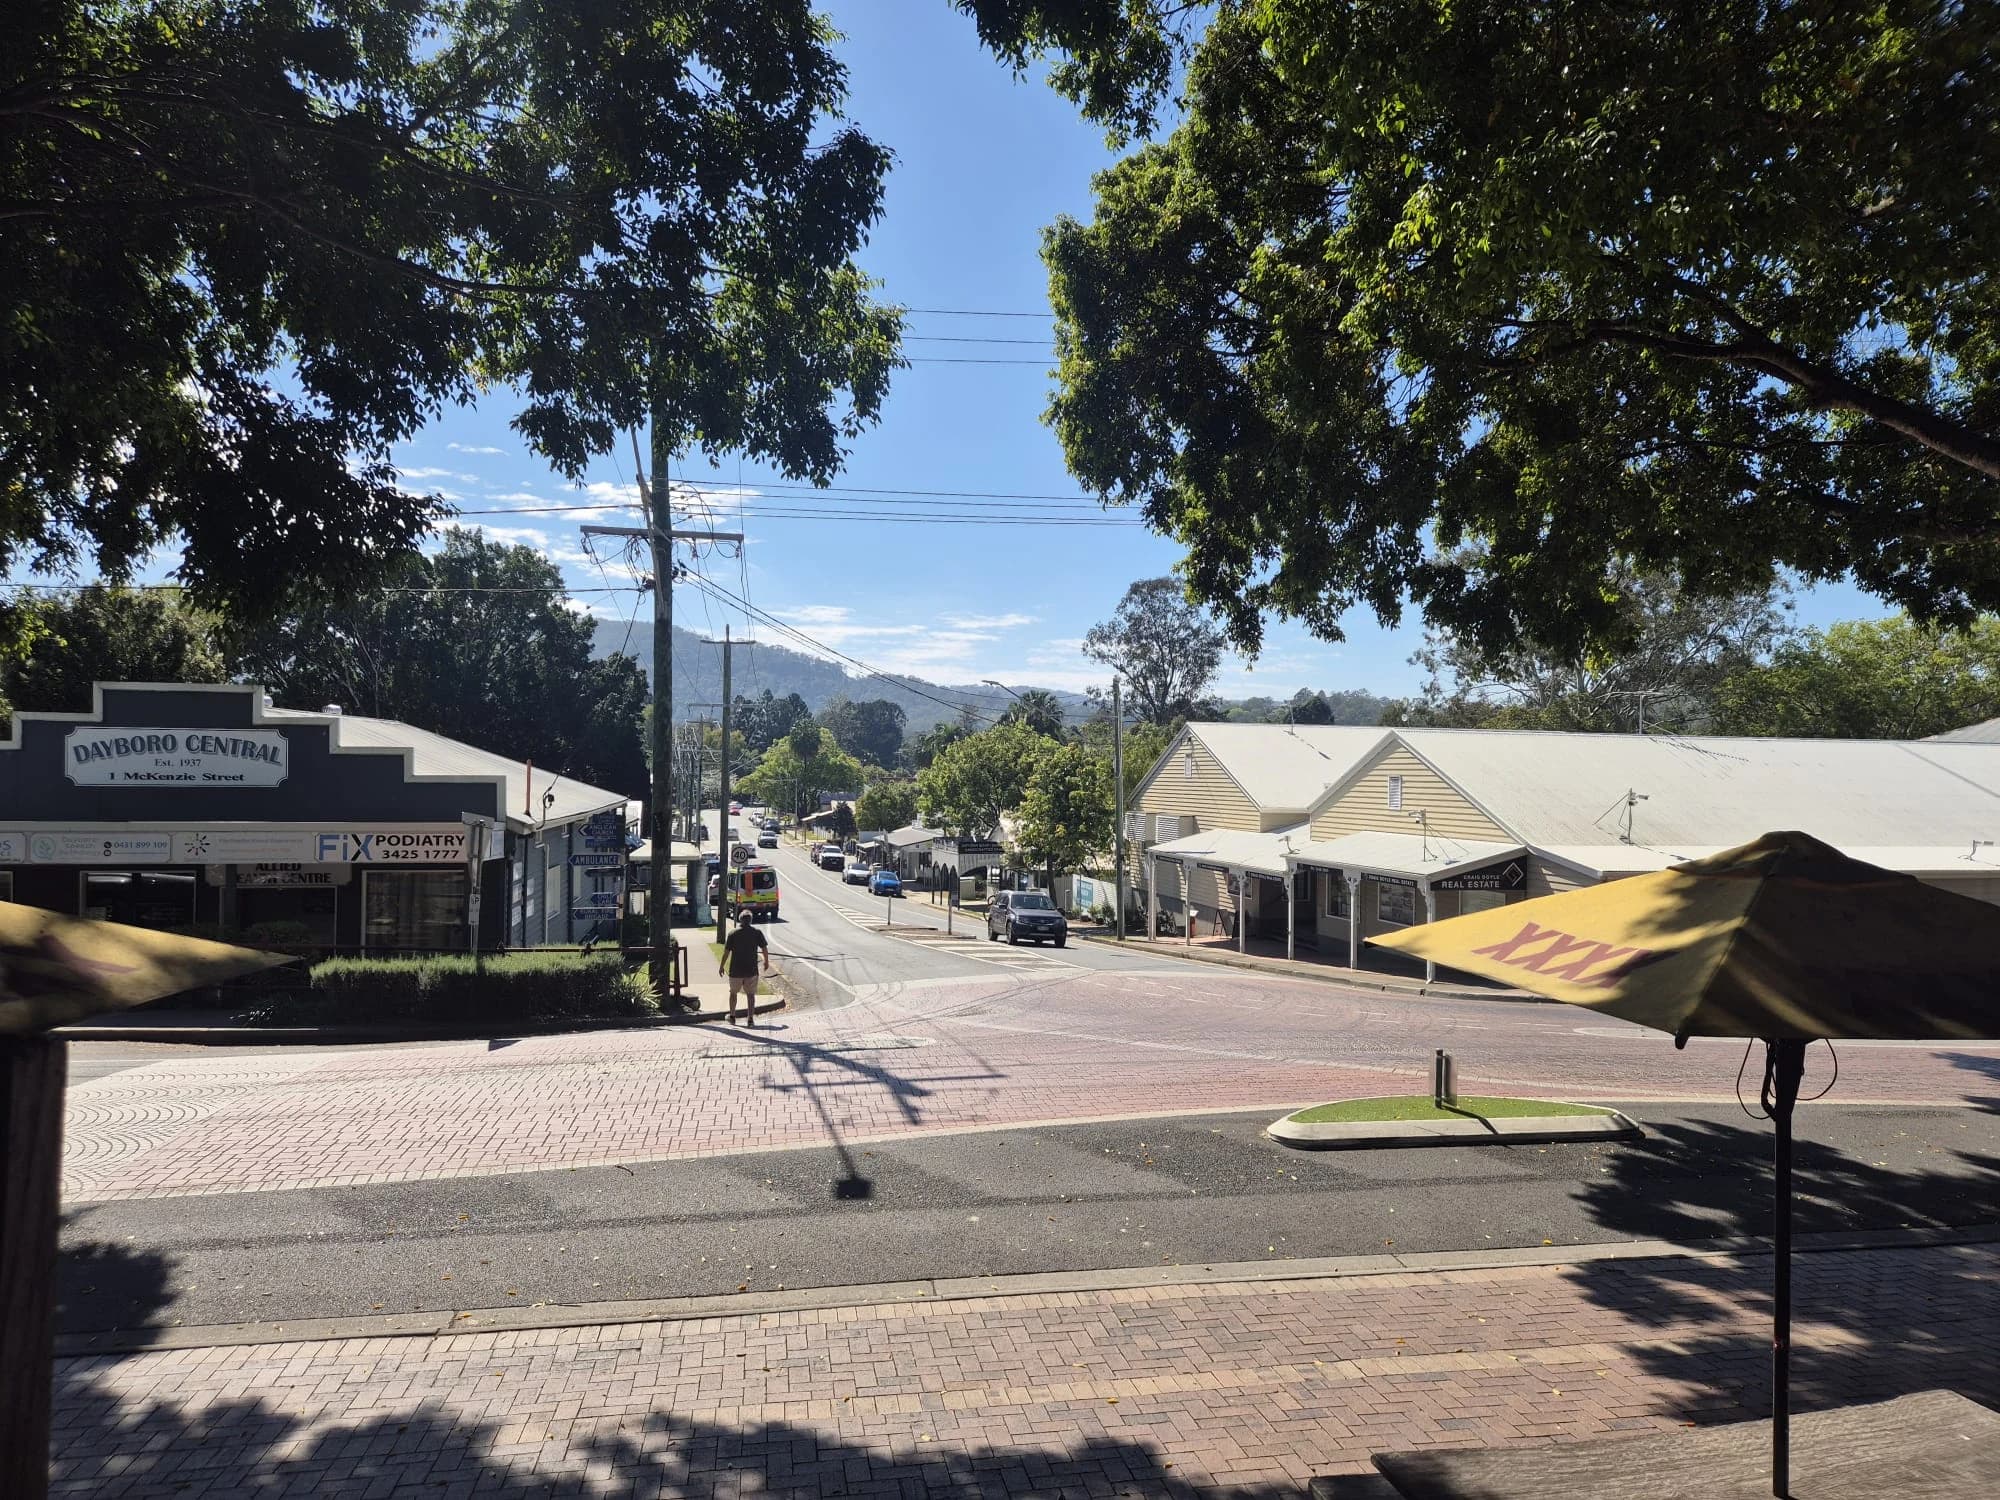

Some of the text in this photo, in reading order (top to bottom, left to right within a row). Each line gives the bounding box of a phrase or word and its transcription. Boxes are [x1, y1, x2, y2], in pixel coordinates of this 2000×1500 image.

[73, 734, 283, 767] DAYBORO CENTRAL
[154, 759, 201, 767] Est. 1937
[109, 772, 245, 781] 1 McKenzie Street
[136, 841, 151, 849] 899
[375, 834, 466, 847] PODIATRY
[383, 850, 460, 859] 3425 1777
[734, 851, 746, 859] 40
[575, 855, 618, 865] AMBULANCE
[256, 862, 301, 872] ALLIED
[1441, 880, 1500, 889] REAL ESTATE
[1471, 922, 1680, 988] XXXX
